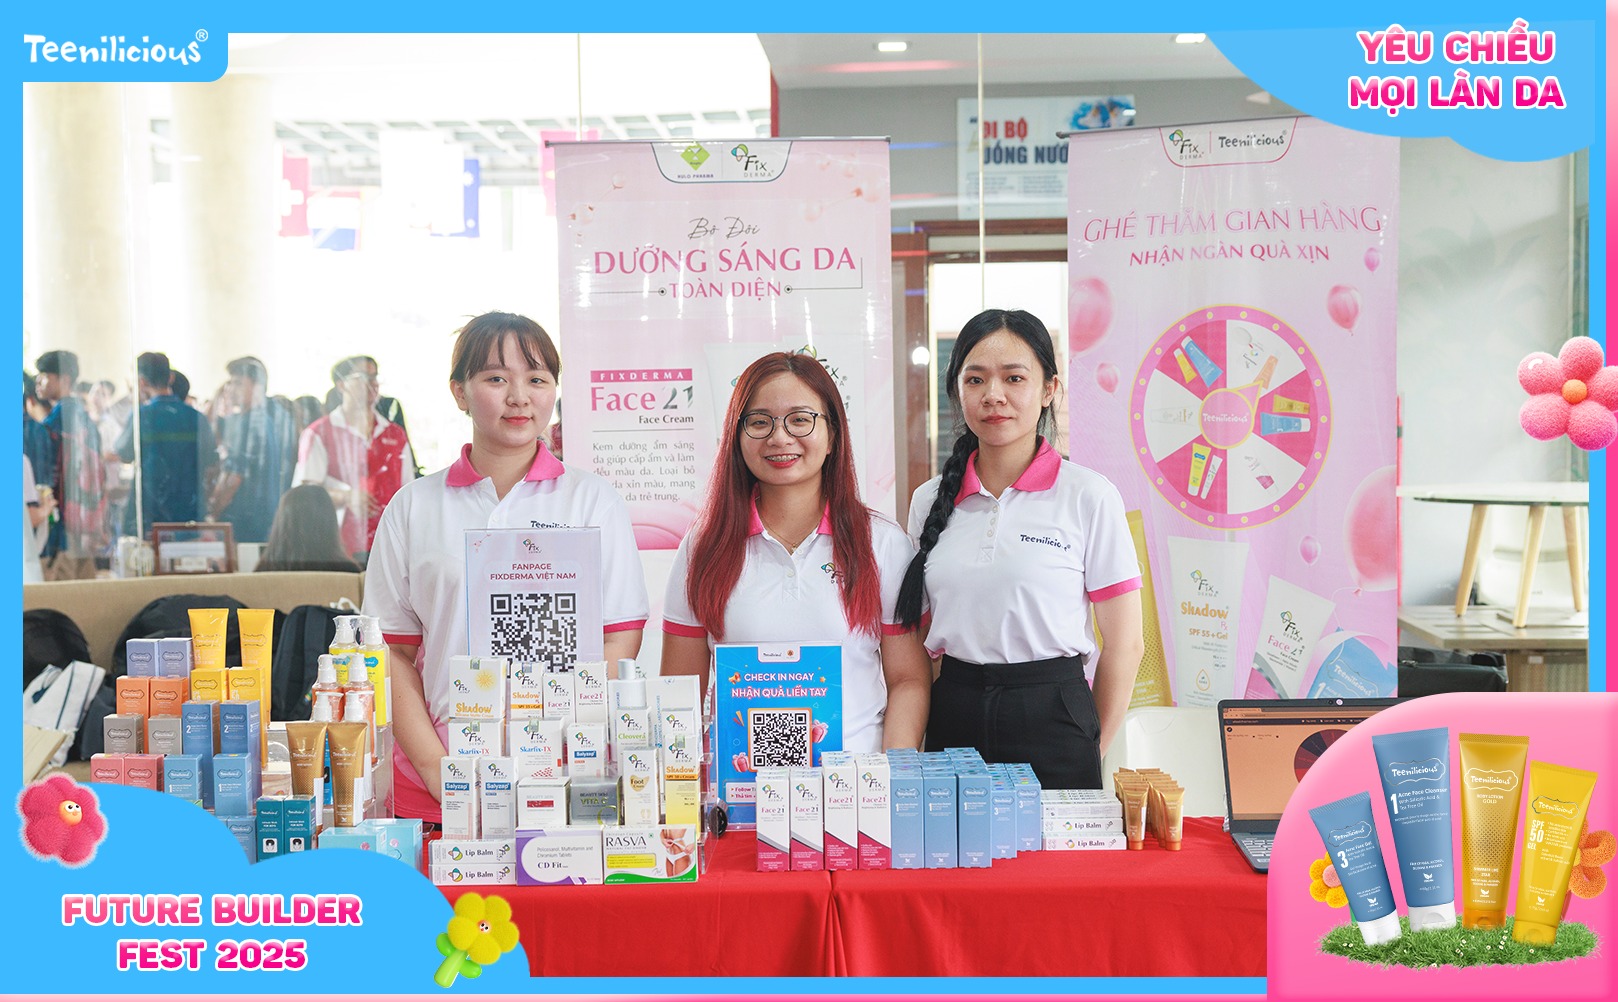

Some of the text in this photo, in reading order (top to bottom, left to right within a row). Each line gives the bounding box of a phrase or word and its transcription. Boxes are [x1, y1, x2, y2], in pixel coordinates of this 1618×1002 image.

[1004, 117, 1028, 143] BỘ
[1179, 139, 1199, 154] Fix
[744, 155, 767, 171] Fix
[1084, 199, 1382, 242] GHÉ THĂM GIAN HÀNG
[724, 216, 761, 239] Đôi
[594, 241, 857, 275] DƯỠNG SÁNG DA
[1129, 240, 1331, 267] NHẬN NGÀN QUÀ XỊN
[669, 276, 782, 302] TOÀN DIỆN
[600, 371, 684, 381] FIXDERMA
[591, 385, 693, 412] Face 21
[639, 415, 694, 424] Face Cream
[592, 440, 695, 452] Kem dưỡng ẩm sáng
[592, 455, 604, 464] da
[606, 455, 627, 466] giúp
[664, 453, 675, 462] và
[677, 453, 695, 462] làm
[615, 468, 635, 476] màu
[660, 466, 679, 477] Loại
[684, 465, 695, 475] bỏ
[670, 480, 696, 490] mang
[625, 493, 637, 502] da
[511, 563, 552, 571] FANPAGE
[490, 571, 576, 582] FIXDERMA VIỆT NAM
[1180, 601, 1229, 619] Shadow
[1188, 628, 1201, 636] SPF
[1268, 634, 1290, 653] Face
[744, 673, 814, 681] CHECK IN NGAY
[731, 686, 760, 700] NHẬN
[809, 688, 828, 697] TAY
[455, 702, 492, 714] Shadow
[186, 725, 192, 734] 2
[223, 725, 229, 733] 2
[631, 777, 644, 785] Foot
[1074, 822, 1085, 831] Lip
[605, 836, 647, 847] RASVA
[1077, 840, 1088, 849] Lip
[465, 849, 475, 857] Lip
[552, 861, 563, 869] Fit
[465, 871, 475, 879] Lip
